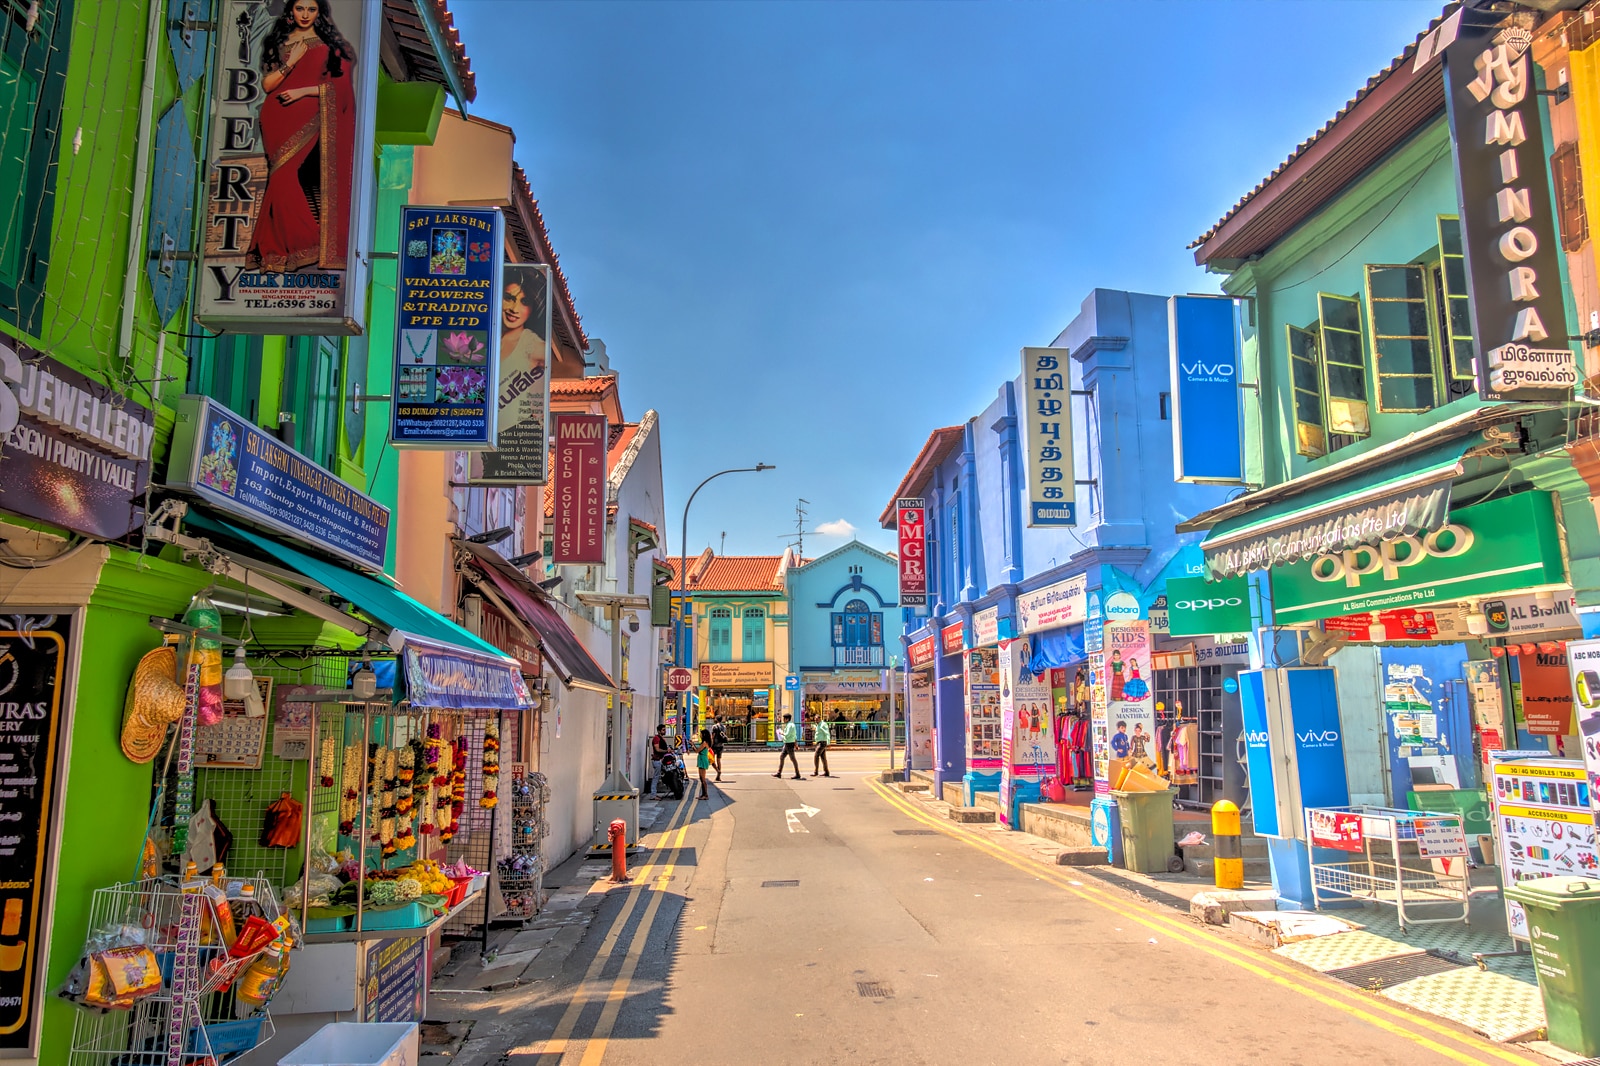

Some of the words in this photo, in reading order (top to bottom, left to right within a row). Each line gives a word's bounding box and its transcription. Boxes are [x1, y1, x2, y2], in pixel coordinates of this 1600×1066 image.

[207, 0, 264, 302] IBERTY
[408, 216, 430, 230] SRI
[434, 214, 492, 232] LAKSHMI
[1485, 109, 1549, 342] MINORA
[239, 273, 280, 288] SILK
[283, 273, 340, 289] HOUSE
[404, 277, 490, 288] VINAYAGAR
[408, 289, 484, 300] FLOWERS
[309, 300, 336, 309] 3861
[410, 316, 433, 325] PTE
[448, 317, 480, 326] LTD
[1181, 360, 1234, 376] vivo
[20, 363, 155, 461] JEWELLERY
[398, 408, 411, 416] 163
[411, 408, 439, 416] DUNLOP
[440, 408, 450, 416] ST
[515, 423, 543, 431] Threading
[560, 422, 602, 439] MKM
[3, 424, 46, 458] ESIGN
[52, 439, 95, 476] PURITY
[101, 459, 137, 492] VALUE
[562, 448, 573, 478] GOLD
[588, 457, 598, 465] &
[246, 431, 261, 456] SRI
[260, 439, 290, 474] LAKSHMI
[290, 457, 322, 492] VINAYAGAR
[322, 476, 346, 505] FLOWERS
[351, 492, 371, 519] TRADING
[244, 478, 263, 492] 163
[264, 487, 294, 508] Dunlop
[356, 531, 379, 549] 209472
[587, 478, 598, 546] BANGLES
[353, 516, 360, 525] &
[360, 519, 380, 537] Retail
[561, 487, 571, 556] COVERINGS
[1225, 555, 1241, 569] AL
[1361, 517, 1382, 532] Pte
[1385, 507, 1408, 528] Ltd
[900, 524, 925, 575] MGR
[1311, 524, 1475, 588] oppo
[1175, 597, 1242, 611] oppo
[1342, 601, 1351, 611] AL
[1351, 599, 1365, 610] Bismi
[1366, 593, 1412, 609] Communications
[1412, 591, 1424, 601] Pte
[1424, 588, 1435, 599] Ltd
[1106, 605, 1139, 614] Lebara
[1510, 606, 1527, 620] AL
[1111, 633, 1146, 643] KID'S
[1574, 652, 1586, 660] ABC
[670, 674, 691, 684] STOP
[13, 735, 40, 743] VALUE
[1245, 729, 1269, 742] vivo
[1296, 729, 1339, 742] vivo
[1527, 810, 1569, 820] ACCESSORIES
